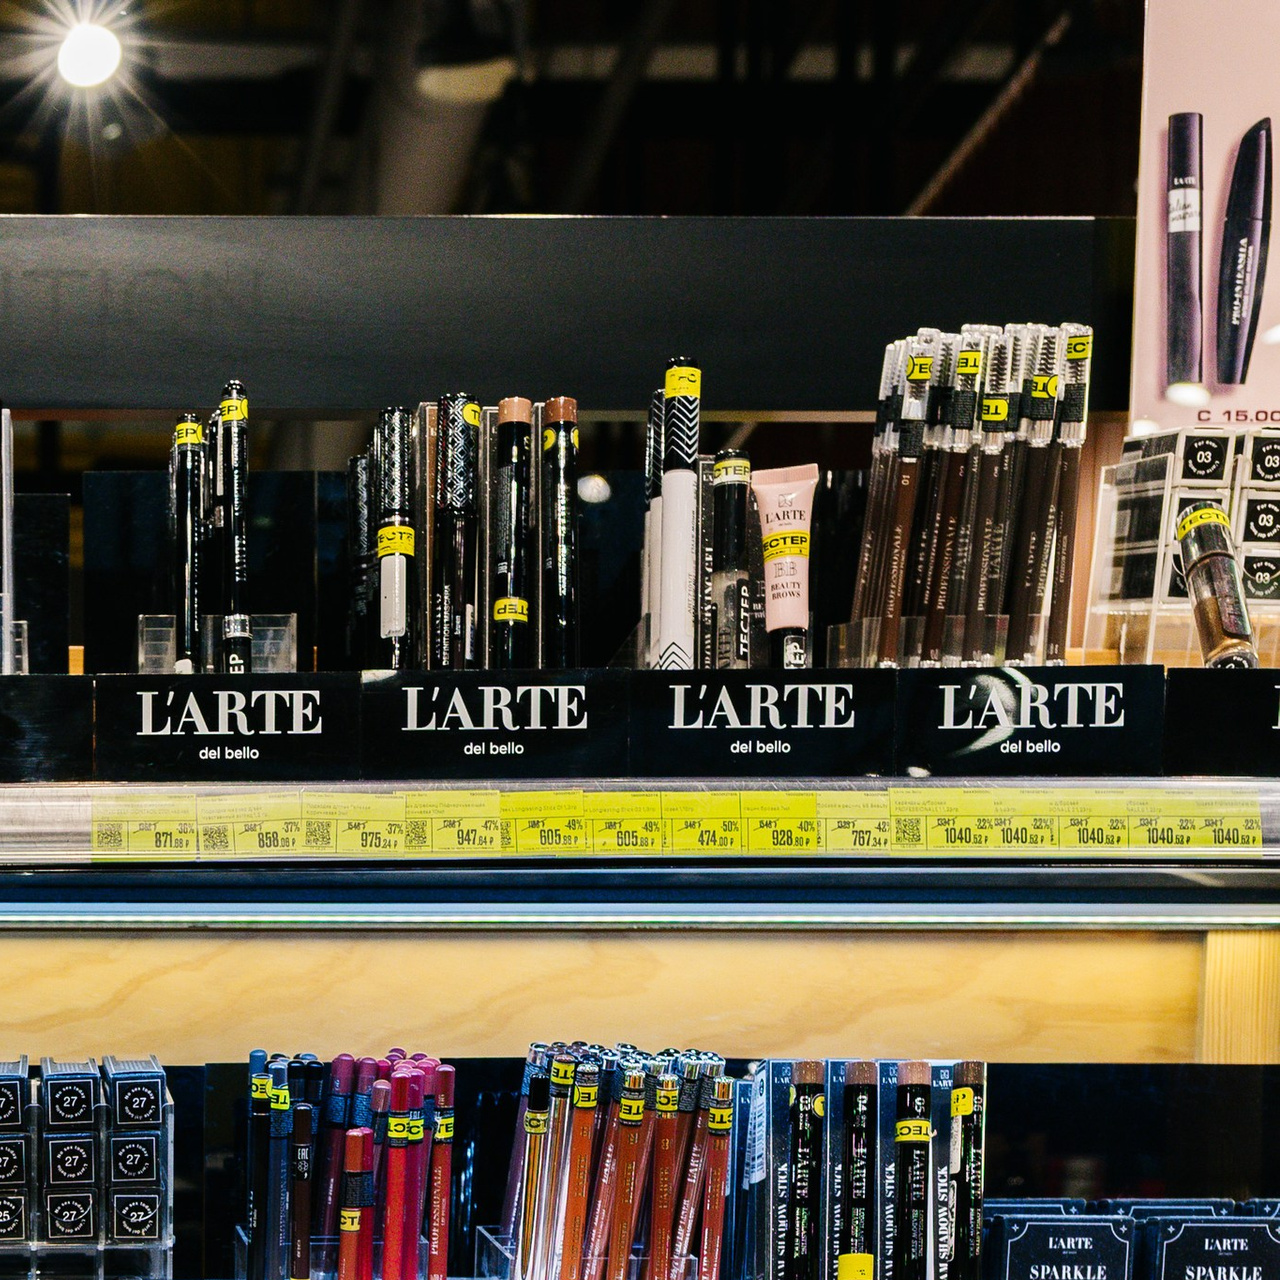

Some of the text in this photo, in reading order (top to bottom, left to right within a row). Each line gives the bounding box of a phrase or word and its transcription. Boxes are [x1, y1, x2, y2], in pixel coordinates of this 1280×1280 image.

[771, 582, 800, 592] BEAUTY
[772, 591, 800, 600] BROWS
[136, 690, 322, 735] L'ARTE
[401, 685, 587, 731] L'ARTE
[668, 684, 855, 729] L'ARTE
[939, 685, 1124, 730] L'ARTE
[63, 1096, 78, 1107] 27
[1030, 1265, 1106, 1280] SPARKLE
